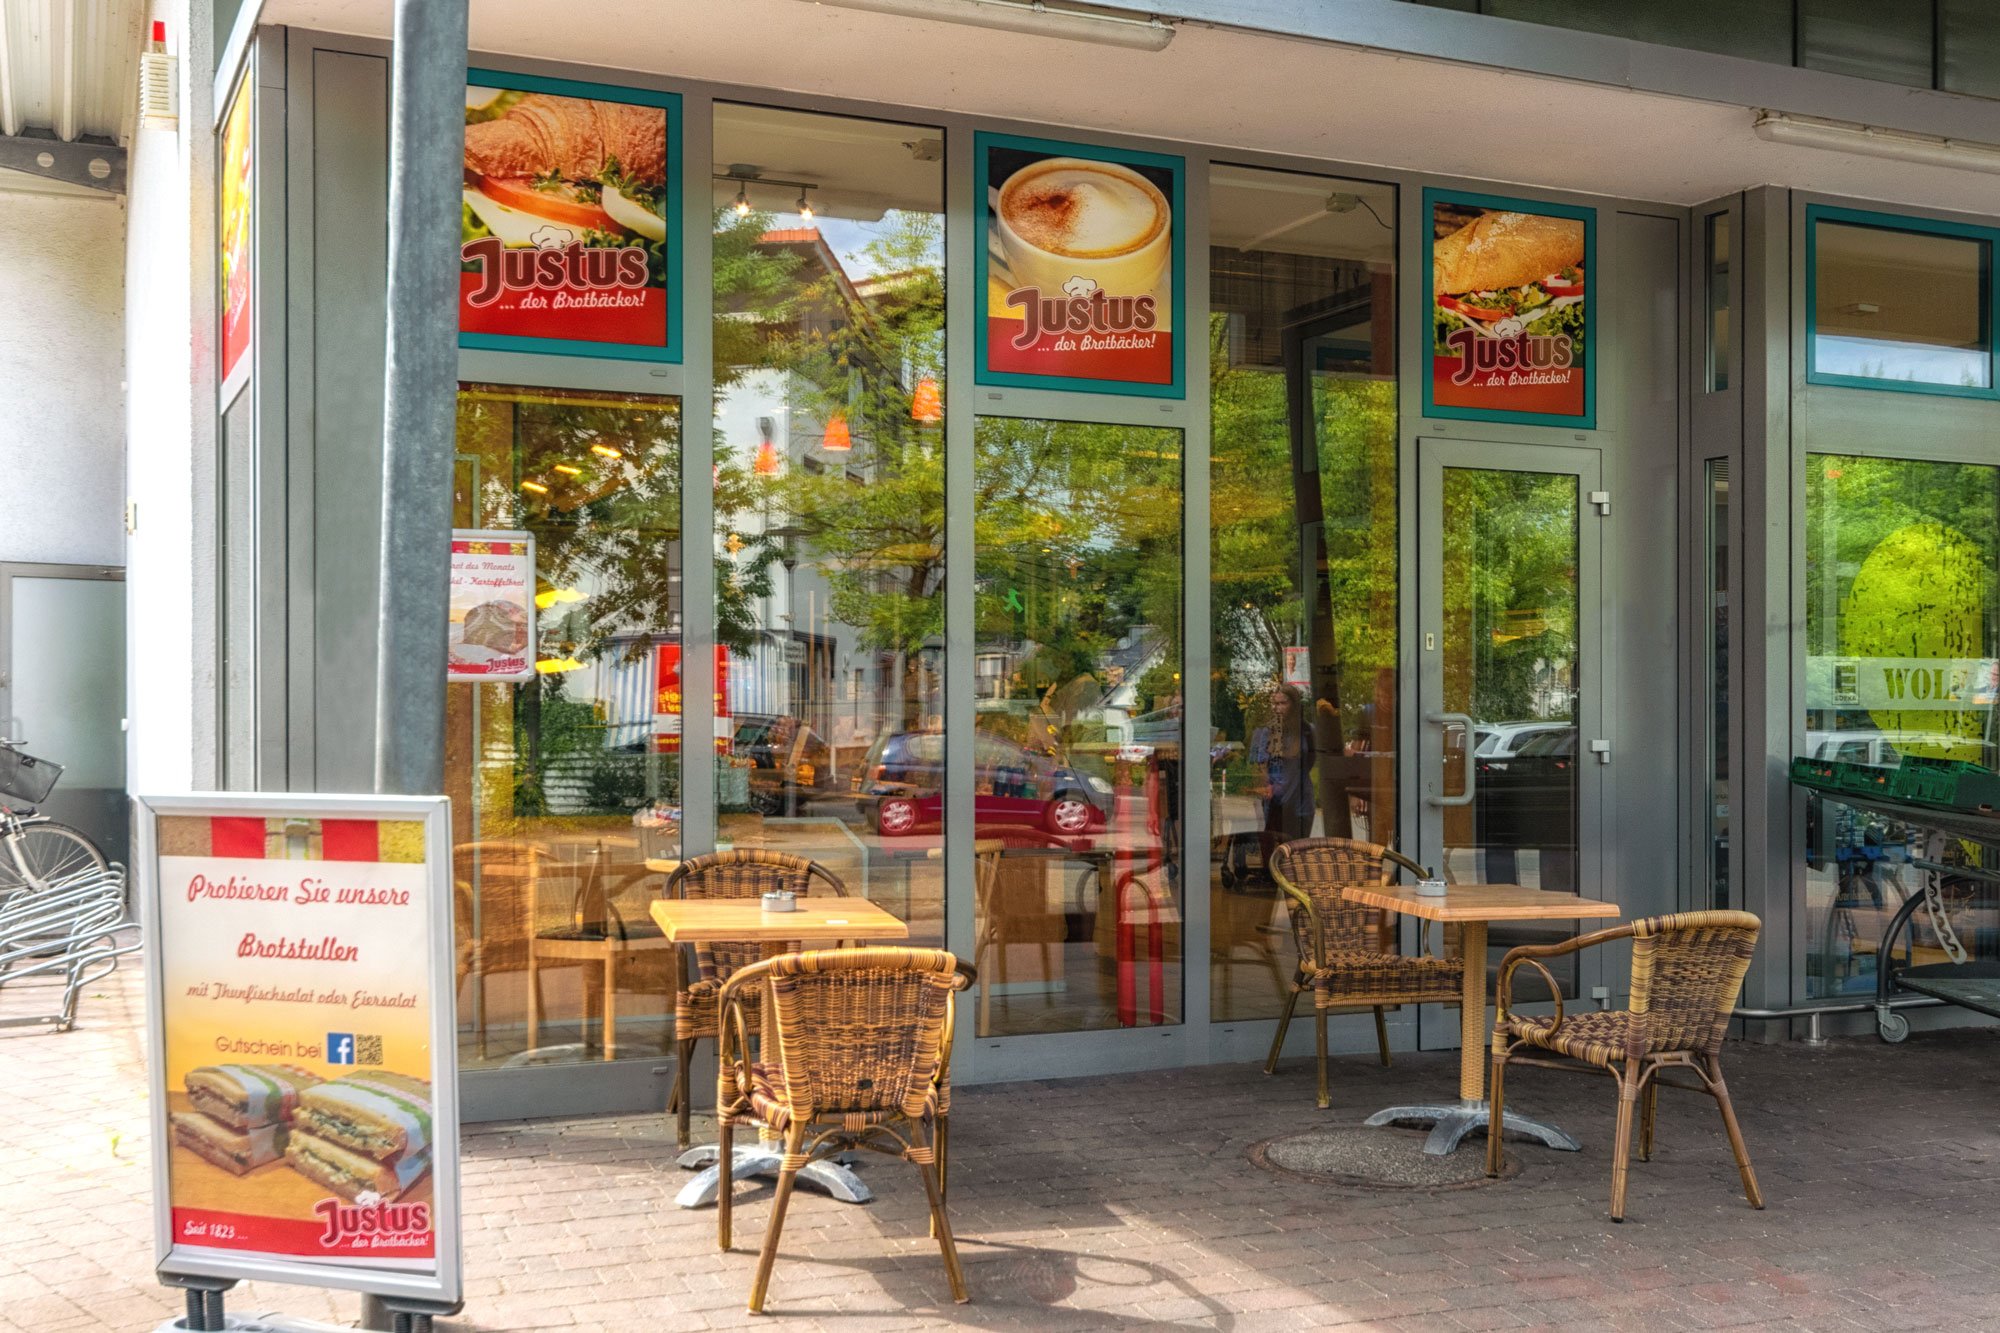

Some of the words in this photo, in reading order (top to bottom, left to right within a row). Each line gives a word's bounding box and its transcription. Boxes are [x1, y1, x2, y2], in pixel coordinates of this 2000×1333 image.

[461, 236, 649, 308] Justus
[519, 292, 548, 309] der
[553, 290, 647, 309] Brotbäcker!
[1005, 286, 1157, 350] Justus
[1054, 336, 1076, 351] der
[1081, 334, 1156, 351] Brotbäcker!
[1446, 327, 1573, 386] Justus
[1486, 373, 1505, 386] der
[1509, 370, 1571, 386] Brotbäcker!
[465, 562, 478, 570] des
[482, 562, 515, 571] Monats
[469, 576, 524, 588] Kartoffelbrot
[486, 657, 526, 672] Justus
[1883, 668, 1968, 700] WOL
[187, 874, 288, 902] Probieren
[295, 878, 331, 905] Sie
[335, 887, 410, 906] unsere
[237, 933, 359, 962] Brotstullen
[187, 982, 209, 996] mit
[212, 982, 314, 1004] Thunfischsalat
[317, 990, 347, 1005] oder
[351, 990, 416, 1009] Eiersalat
[215, 1036, 293, 1057] Gutschein
[296, 1041, 322, 1058] bei
[183, 1220, 207, 1235] Seit
[209, 1224, 235, 1239] 1823
[313, 1197, 430, 1248] Justus
[351, 1236, 368, 1248] der
[371, 1234, 429, 1248] Brotbäcker!
